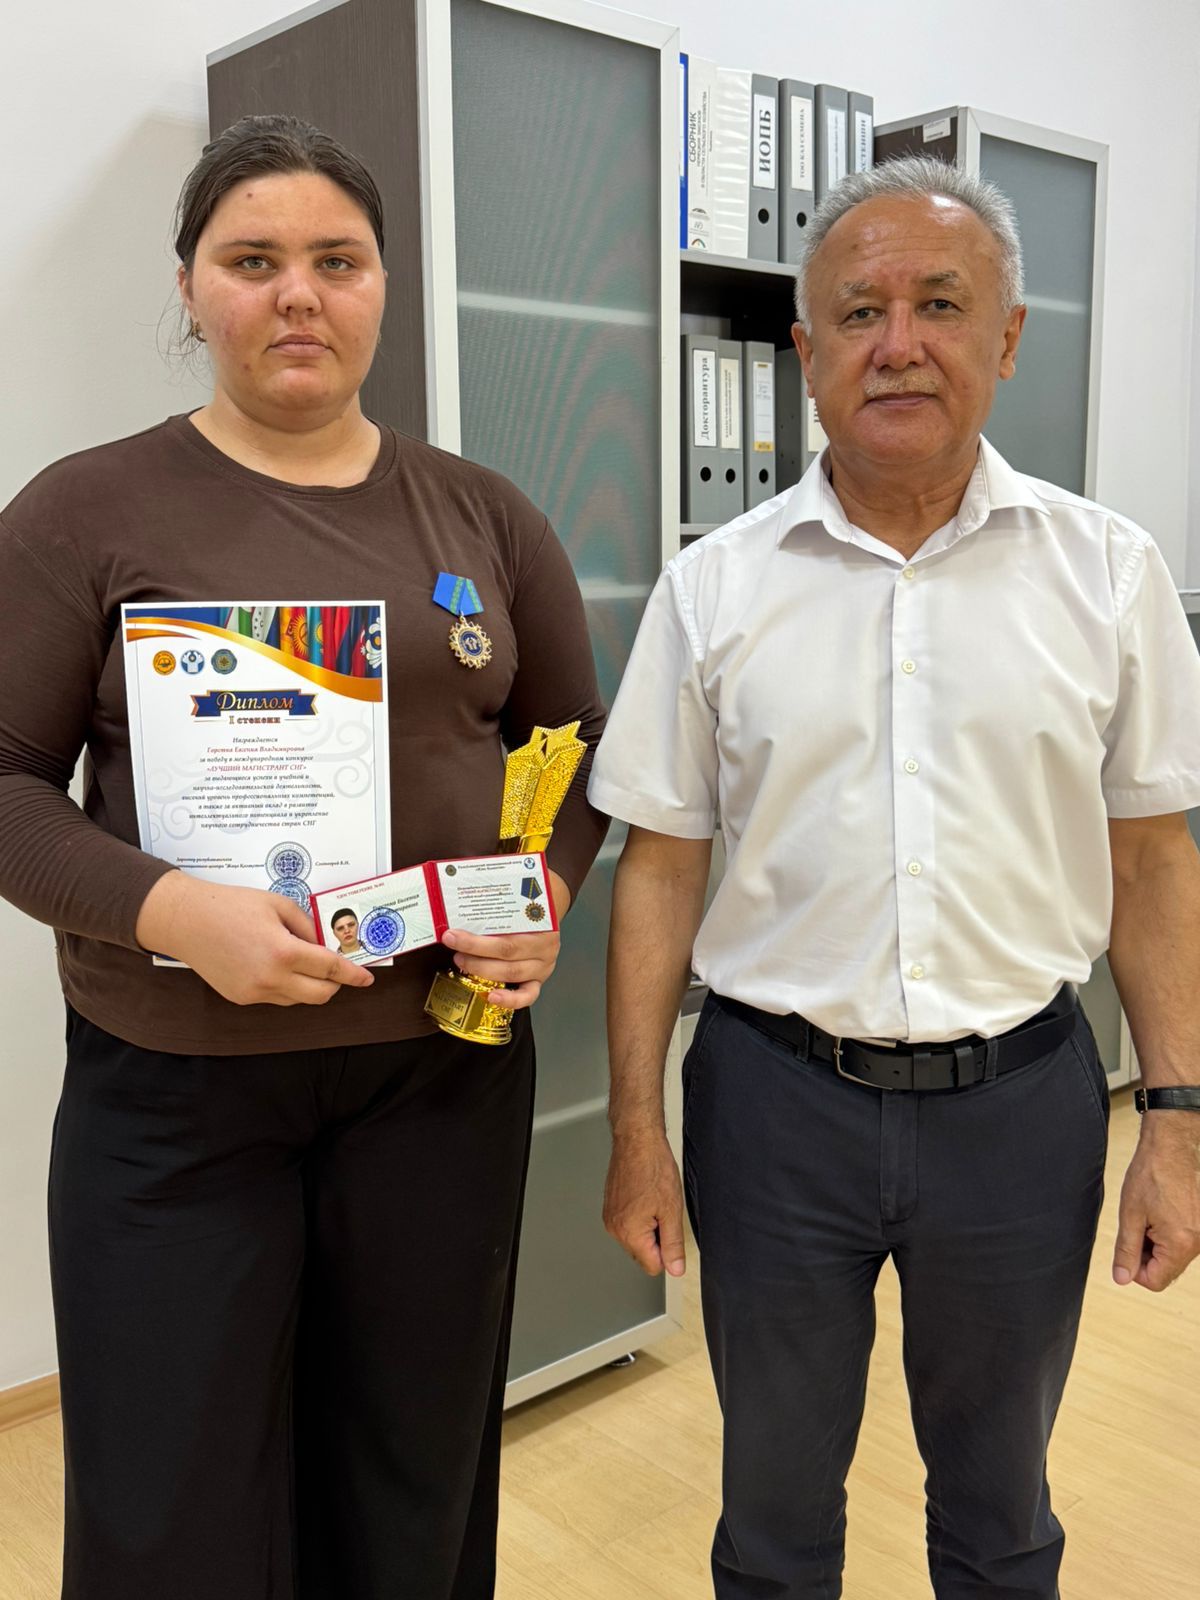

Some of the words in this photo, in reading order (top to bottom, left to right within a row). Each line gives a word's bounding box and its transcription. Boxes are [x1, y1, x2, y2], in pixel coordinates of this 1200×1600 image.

[689, 112, 697, 163] СБОРНИК
[759, 109, 771, 173] ИОПБ
[700, 358, 710, 440] Докторантура
[217, 692, 293, 710] Диплом
